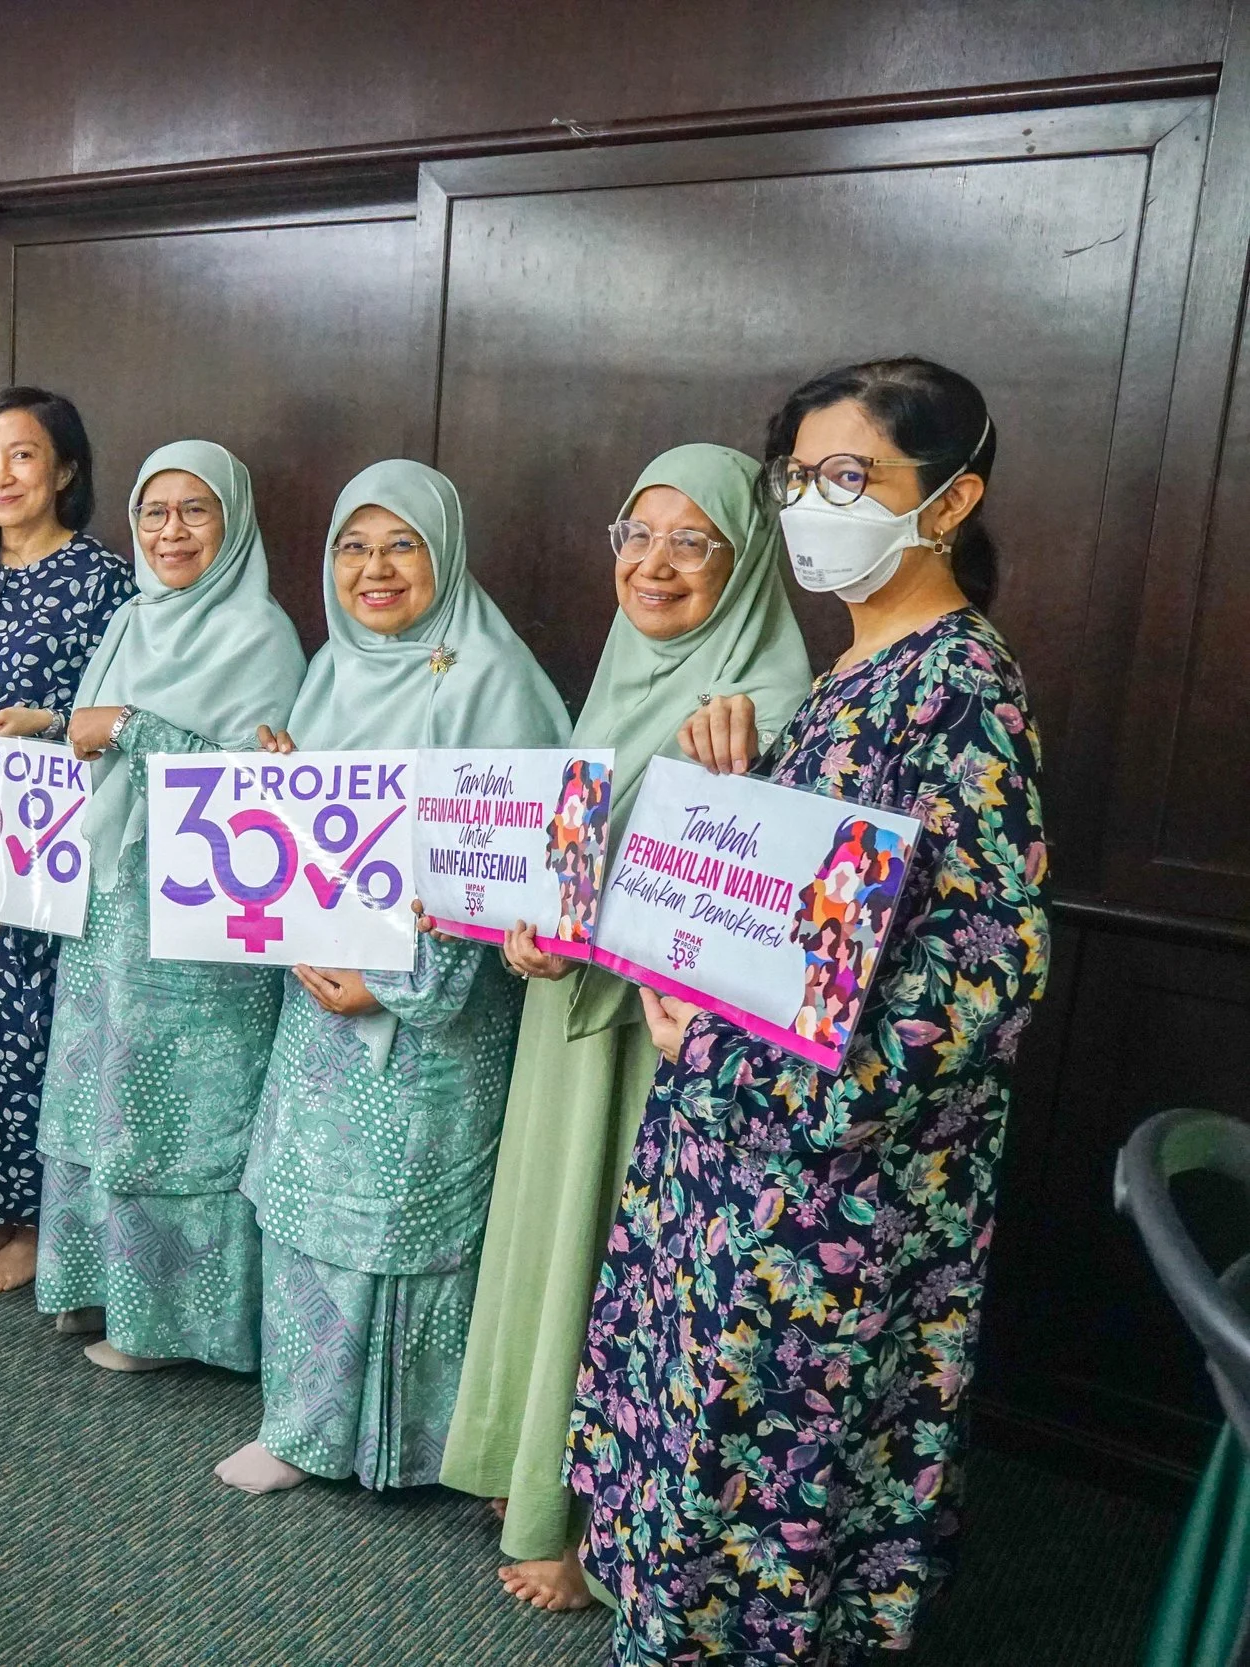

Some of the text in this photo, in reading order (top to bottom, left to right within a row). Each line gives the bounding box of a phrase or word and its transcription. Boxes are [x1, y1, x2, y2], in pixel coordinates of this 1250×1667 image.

[796, 554, 814, 567] 3M
[233, 764, 408, 801] PROJEK
[453, 762, 514, 799] Tambah
[417, 797, 543, 829] PERWAKILAN WANITA
[680, 804, 759, 860] Tambah
[160, 766, 407, 953] 30%
[623, 832, 794, 916] PERWAKILAN WANITA
[465, 883, 485, 892] IMPAK
[674, 929, 703, 947] IMPAK
[689, 893, 787, 948] Demokrasi
[680, 941, 701, 953] PROJEK
